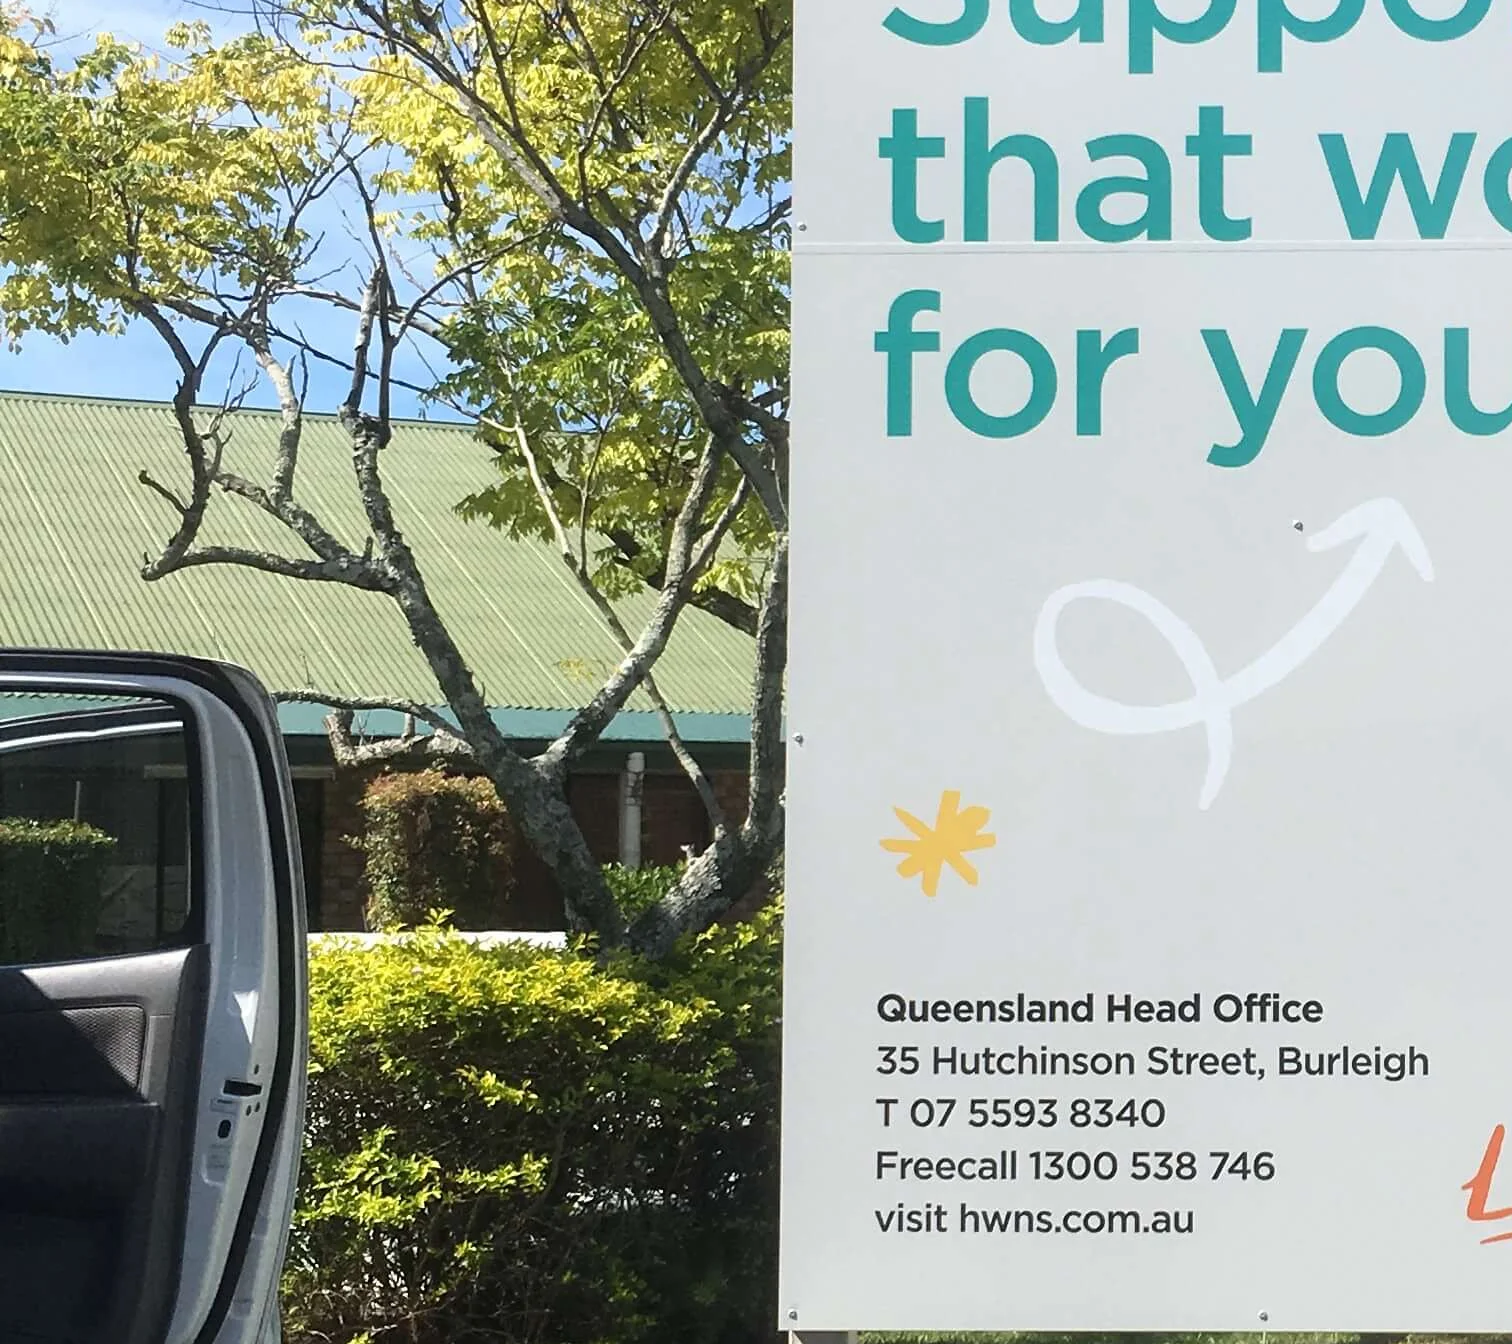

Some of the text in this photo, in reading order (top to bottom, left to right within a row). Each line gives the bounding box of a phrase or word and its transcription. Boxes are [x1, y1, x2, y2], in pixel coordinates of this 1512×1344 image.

[877, 95, 1253, 244] that
[873, 288, 1140, 440] for
[876, 992, 1324, 1024] Queensland Head Office
[876, 1044, 1429, 1082] 35 Hutchinson Street, Burleigh
[875, 1098, 1166, 1129] T 07 5593 8340
[876, 1149, 1276, 1182] Freecall 1300 538 746
[874, 1202, 1194, 1234] visit hwns.com.au
